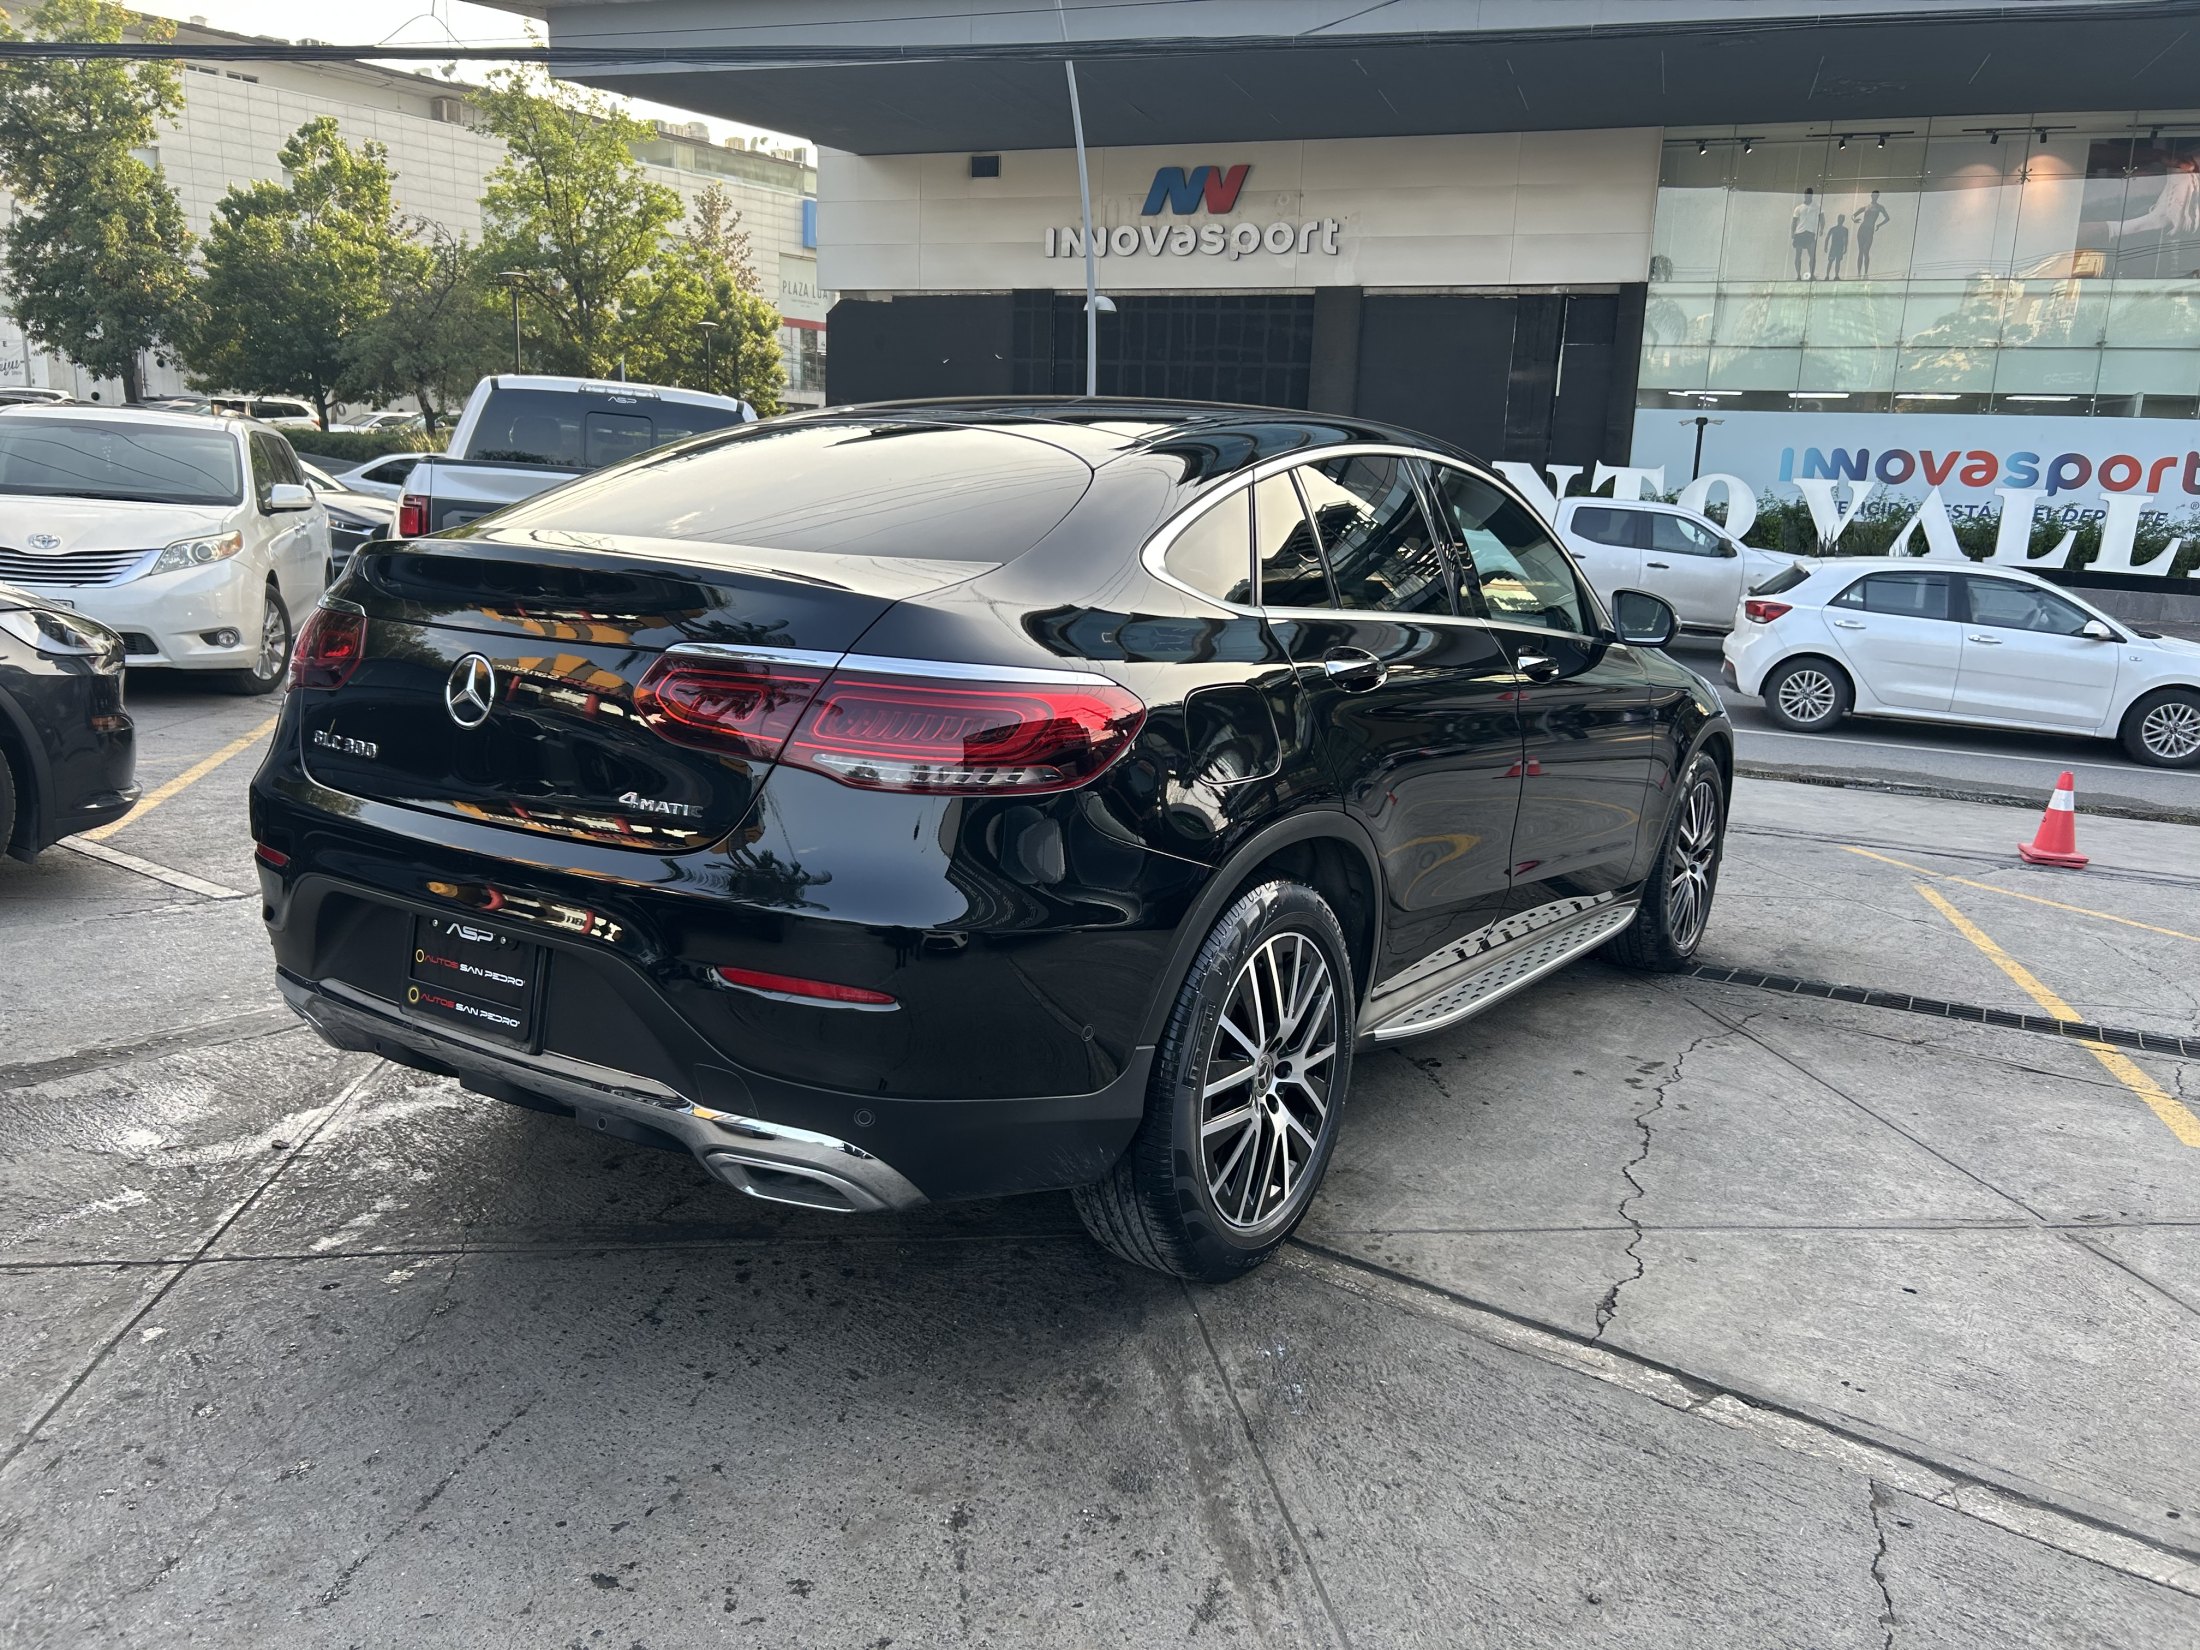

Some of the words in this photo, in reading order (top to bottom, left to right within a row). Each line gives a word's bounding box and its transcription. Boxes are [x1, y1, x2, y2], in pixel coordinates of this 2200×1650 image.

[782, 280, 809, 298] PLAZA
[1793, 478, 2200, 578] VALL
[314, 730, 342, 749] GLC
[343, 737, 378, 758] 300
[618, 791, 704, 818] 4MATIC
[446, 923, 494, 942] ASP
[424, 955, 459, 969] AUTOS
[460, 963, 483, 976] SAN
[484, 970, 524, 987] PEDRO
[420, 993, 455, 1008] AUTOS
[455, 1003, 479, 1016] SAN
